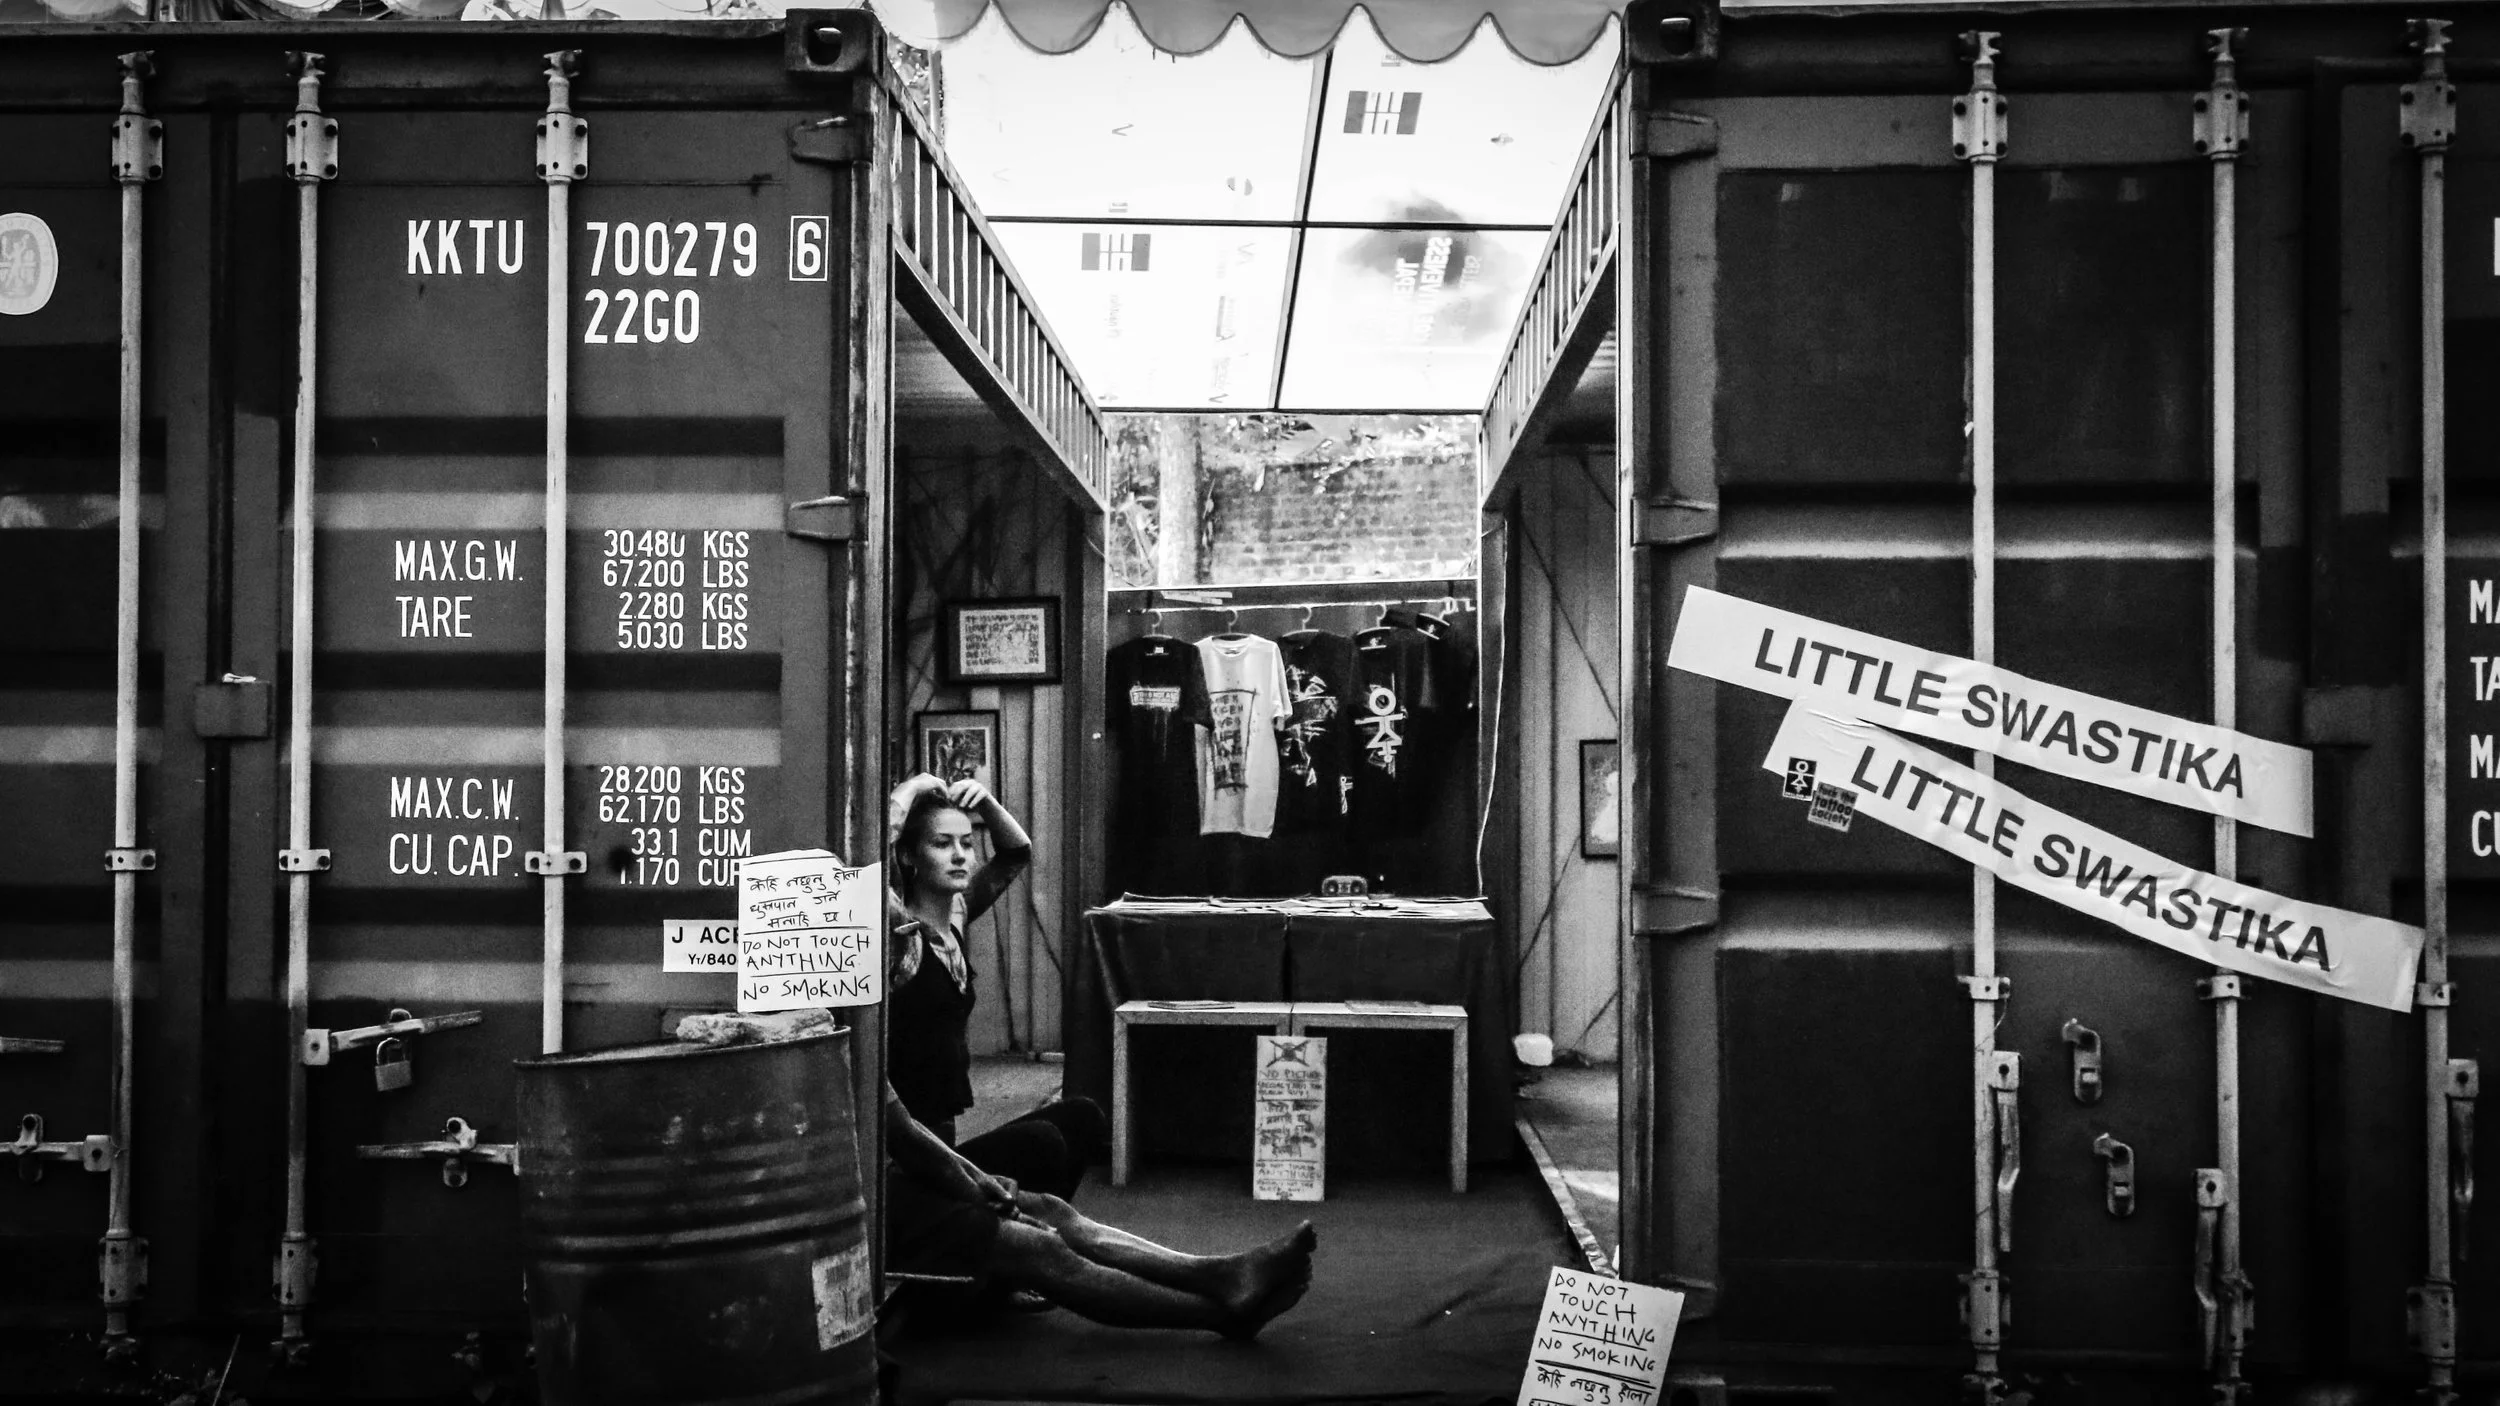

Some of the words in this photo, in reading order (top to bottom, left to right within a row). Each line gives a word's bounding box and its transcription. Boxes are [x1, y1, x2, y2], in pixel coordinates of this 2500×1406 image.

[408, 220, 523, 274] KKTU
[587, 222, 756, 276] 700279
[797, 222, 821, 275] 6
[704, 531, 749, 558] KGS
[396, 540, 523, 581] MAX.G.W.
[604, 559, 684, 587] 67.200
[703, 560, 748, 588] LBS
[396, 596, 472, 637] TARE
[619, 592, 683, 619] 2.280
[703, 592, 748, 620] KGS
[618, 621, 683, 649] 5.030
[702, 622, 747, 649] LBS
[1754, 628, 1948, 717] LITTLE
[1961, 683, 2246, 799] SWASTIKA
[600, 765, 680, 793] 28.200
[700, 766, 745, 794] KGS
[391, 777, 518, 820] MAX.C.W.
[600, 795, 680, 823] 62.170
[699, 796, 744, 824] LBS
[448, 835, 518, 876] CAP.
[632, 828, 677, 855] 33.1
[1851, 746, 2024, 858] LITTLE
[2034, 834, 2332, 972] SWASTIKA
[672, 927, 683, 944] J
[743, 940, 761, 955] DO
[768, 936, 800, 949] NOT
[810, 933, 870, 952] TOUCH
[746, 951, 858, 972] ANYTHING
[743, 984, 769, 1001] NO
[780, 974, 871, 999] SMOKING
[1554, 1273, 1576, 1287] DO
[1587, 1281, 1629, 1300] NOT
[1559, 1293, 1636, 1324] TOUCH
[1549, 1311, 1655, 1346] ANYTHING
[1538, 1337, 1562, 1349] NO
[1572, 1342, 1656, 1371] SMOKING
